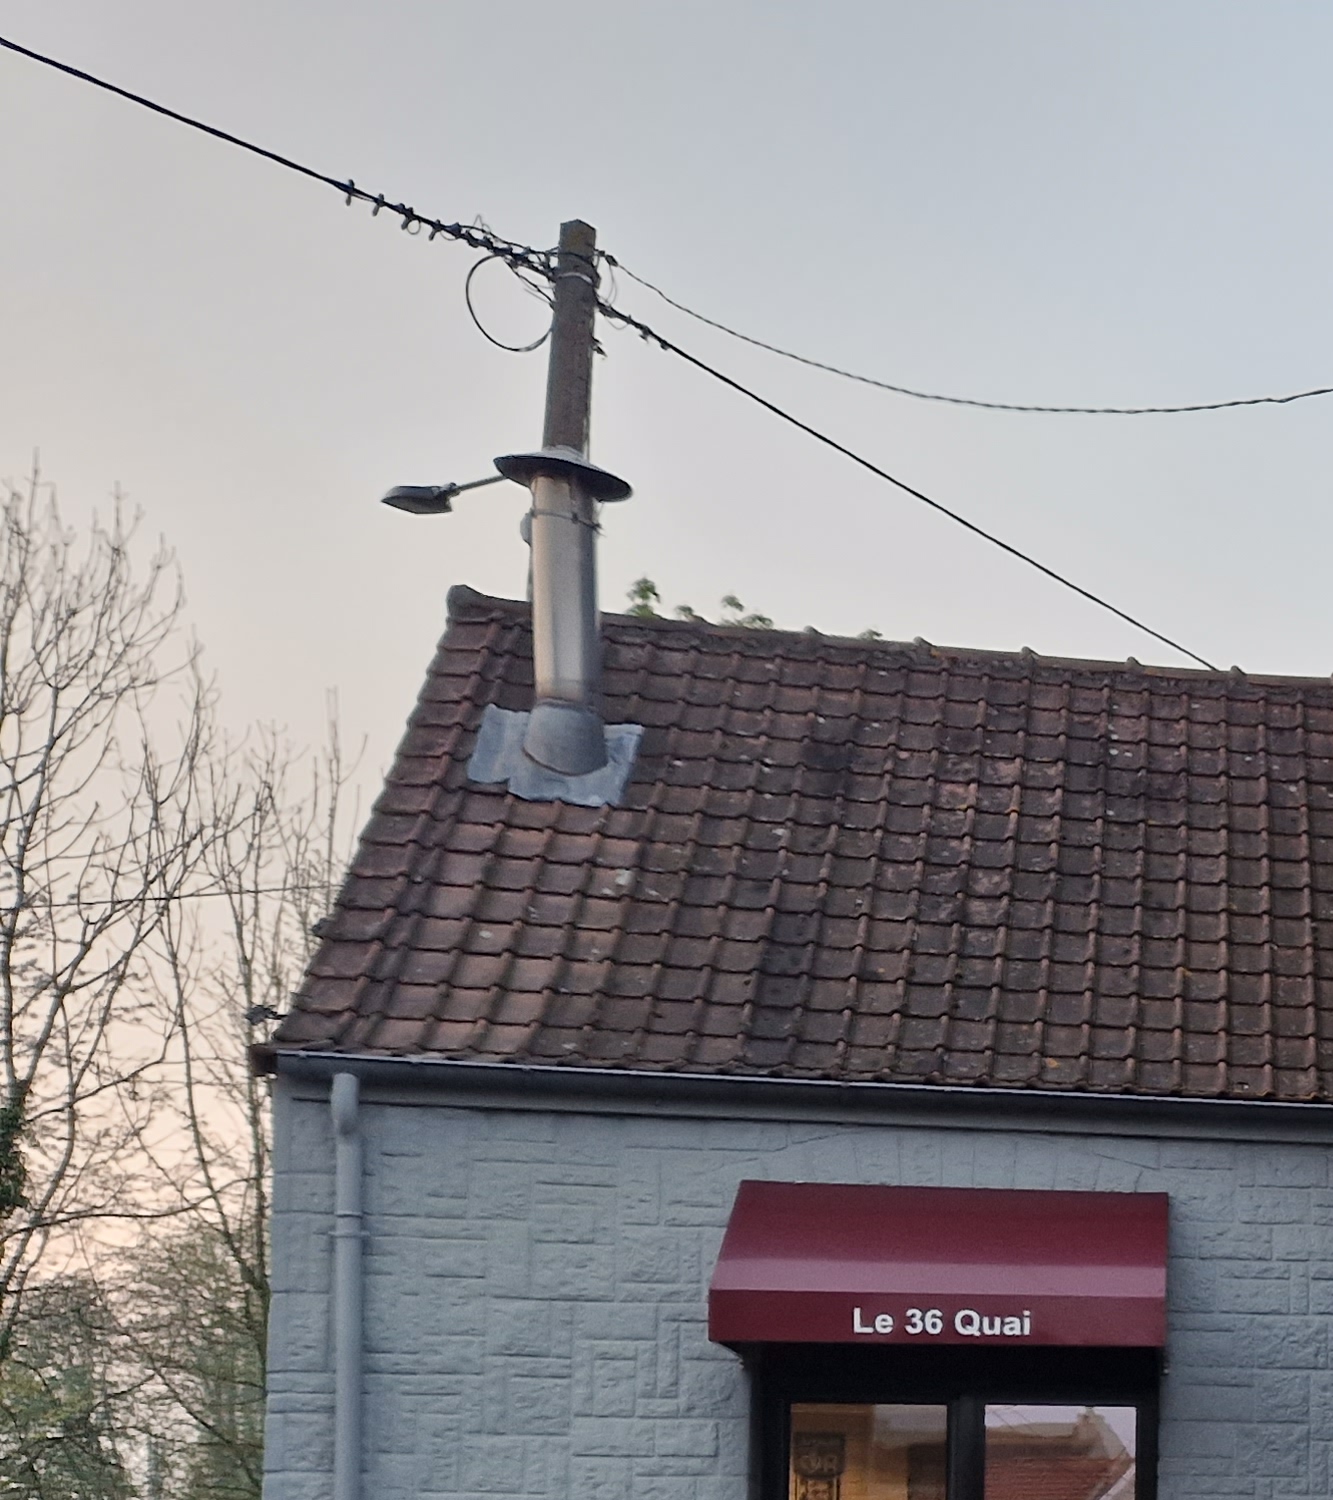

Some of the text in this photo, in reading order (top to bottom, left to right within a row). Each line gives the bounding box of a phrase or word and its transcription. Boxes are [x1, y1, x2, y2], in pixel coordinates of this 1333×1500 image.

[853, 1307, 1031, 1337] Le 36 Quai
